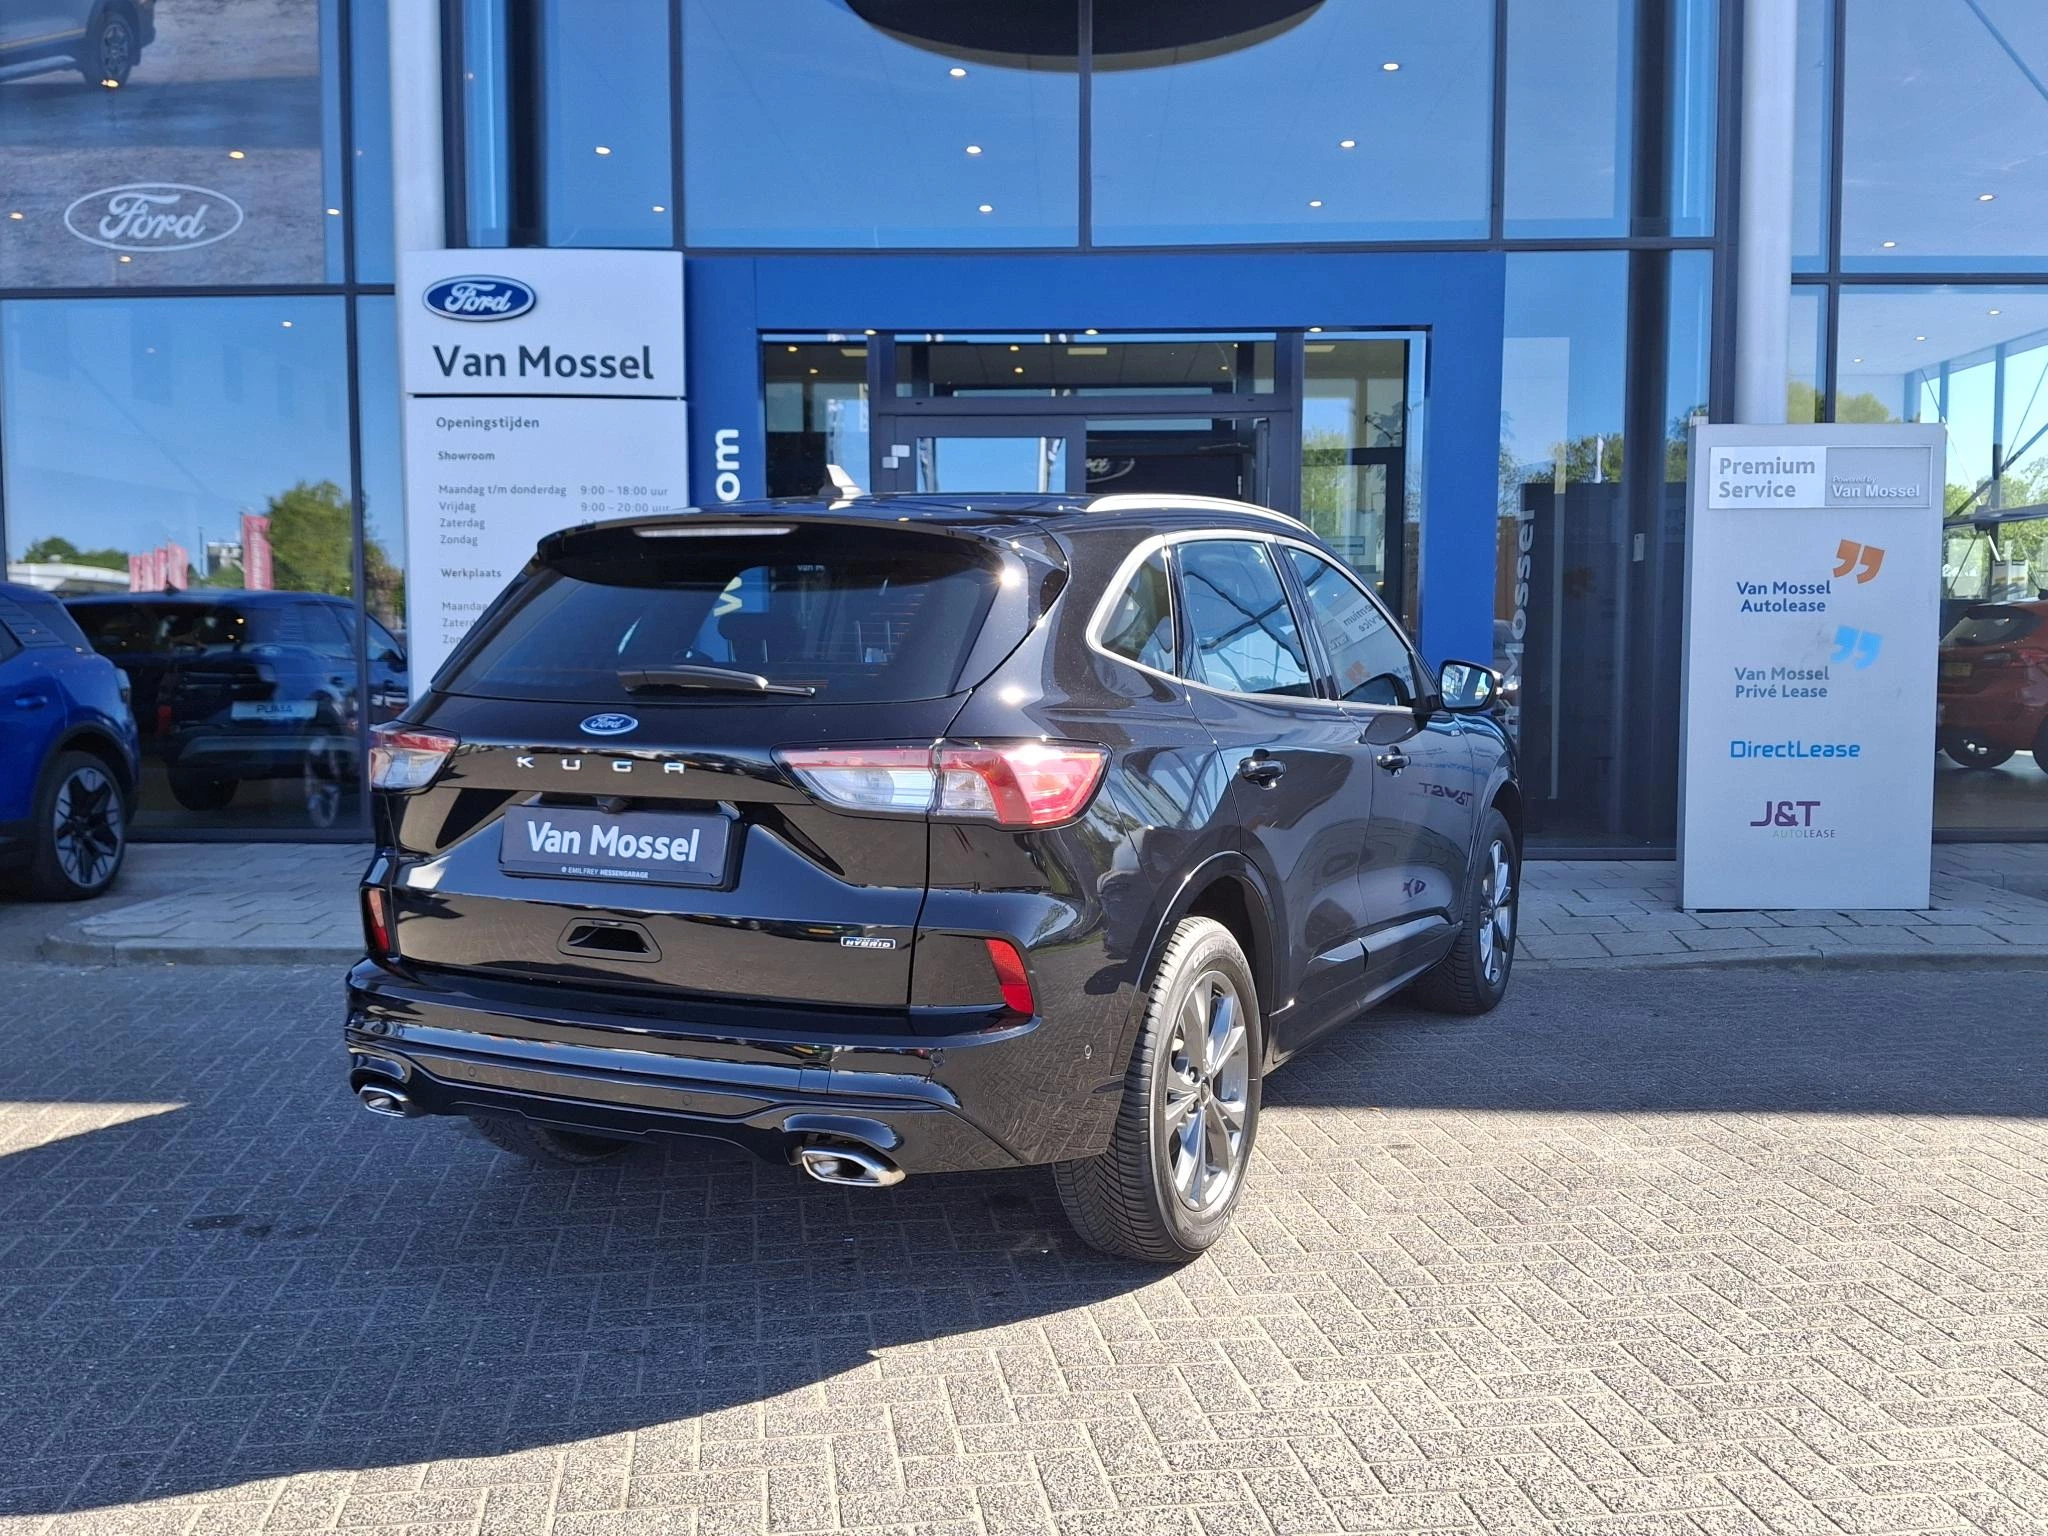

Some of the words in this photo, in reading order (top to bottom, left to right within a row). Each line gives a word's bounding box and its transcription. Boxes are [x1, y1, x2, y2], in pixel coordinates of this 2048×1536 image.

[99, 192, 208, 240] Ford
[444, 282, 512, 312] Ford
[432, 345, 506, 377] Van
[518, 345, 654, 380] Mossel
[435, 416, 540, 432] Openingstijden
[438, 450, 496, 461] Showroom
[1719, 456, 1815, 475] Premium
[439, 485, 485, 497] Maandag
[487, 485, 508, 494] t/m
[510, 485, 568, 497] donderdag
[580, 485, 605, 495] 9:00
[617, 486, 648, 496] 18:00
[650, 488, 668, 496] uur
[1718, 480, 1797, 498] Service
[1832, 484, 1861, 498] Van
[1865, 484, 1921, 498] Mossel
[439, 502, 477, 513] Vrijdag
[580, 502, 606, 512] 9:00
[439, 518, 486, 530] Zaterdag
[439, 534, 478, 547] Zondag
[441, 568, 502, 580] Werkplaats
[1737, 581, 1767, 595] Van
[1772, 580, 1831, 595] Mossel
[1741, 598, 1826, 613] Autolease
[1735, 667, 1766, 681] Van
[1771, 666, 1830, 681] Mossel
[1735, 684, 1777, 698] Privé
[1782, 684, 1828, 698] Lease
[590, 716, 625, 729] Ford
[1730, 740, 1861, 758] DirectLease
[516, 756, 685, 774] KUGA
[1750, 801, 1821, 827] J&T
[527, 820, 581, 855] Van
[589, 823, 700, 863] Mossel
[1772, 829, 1836, 839] AUTOLEASE
[845, 939, 892, 949] HYBRID
